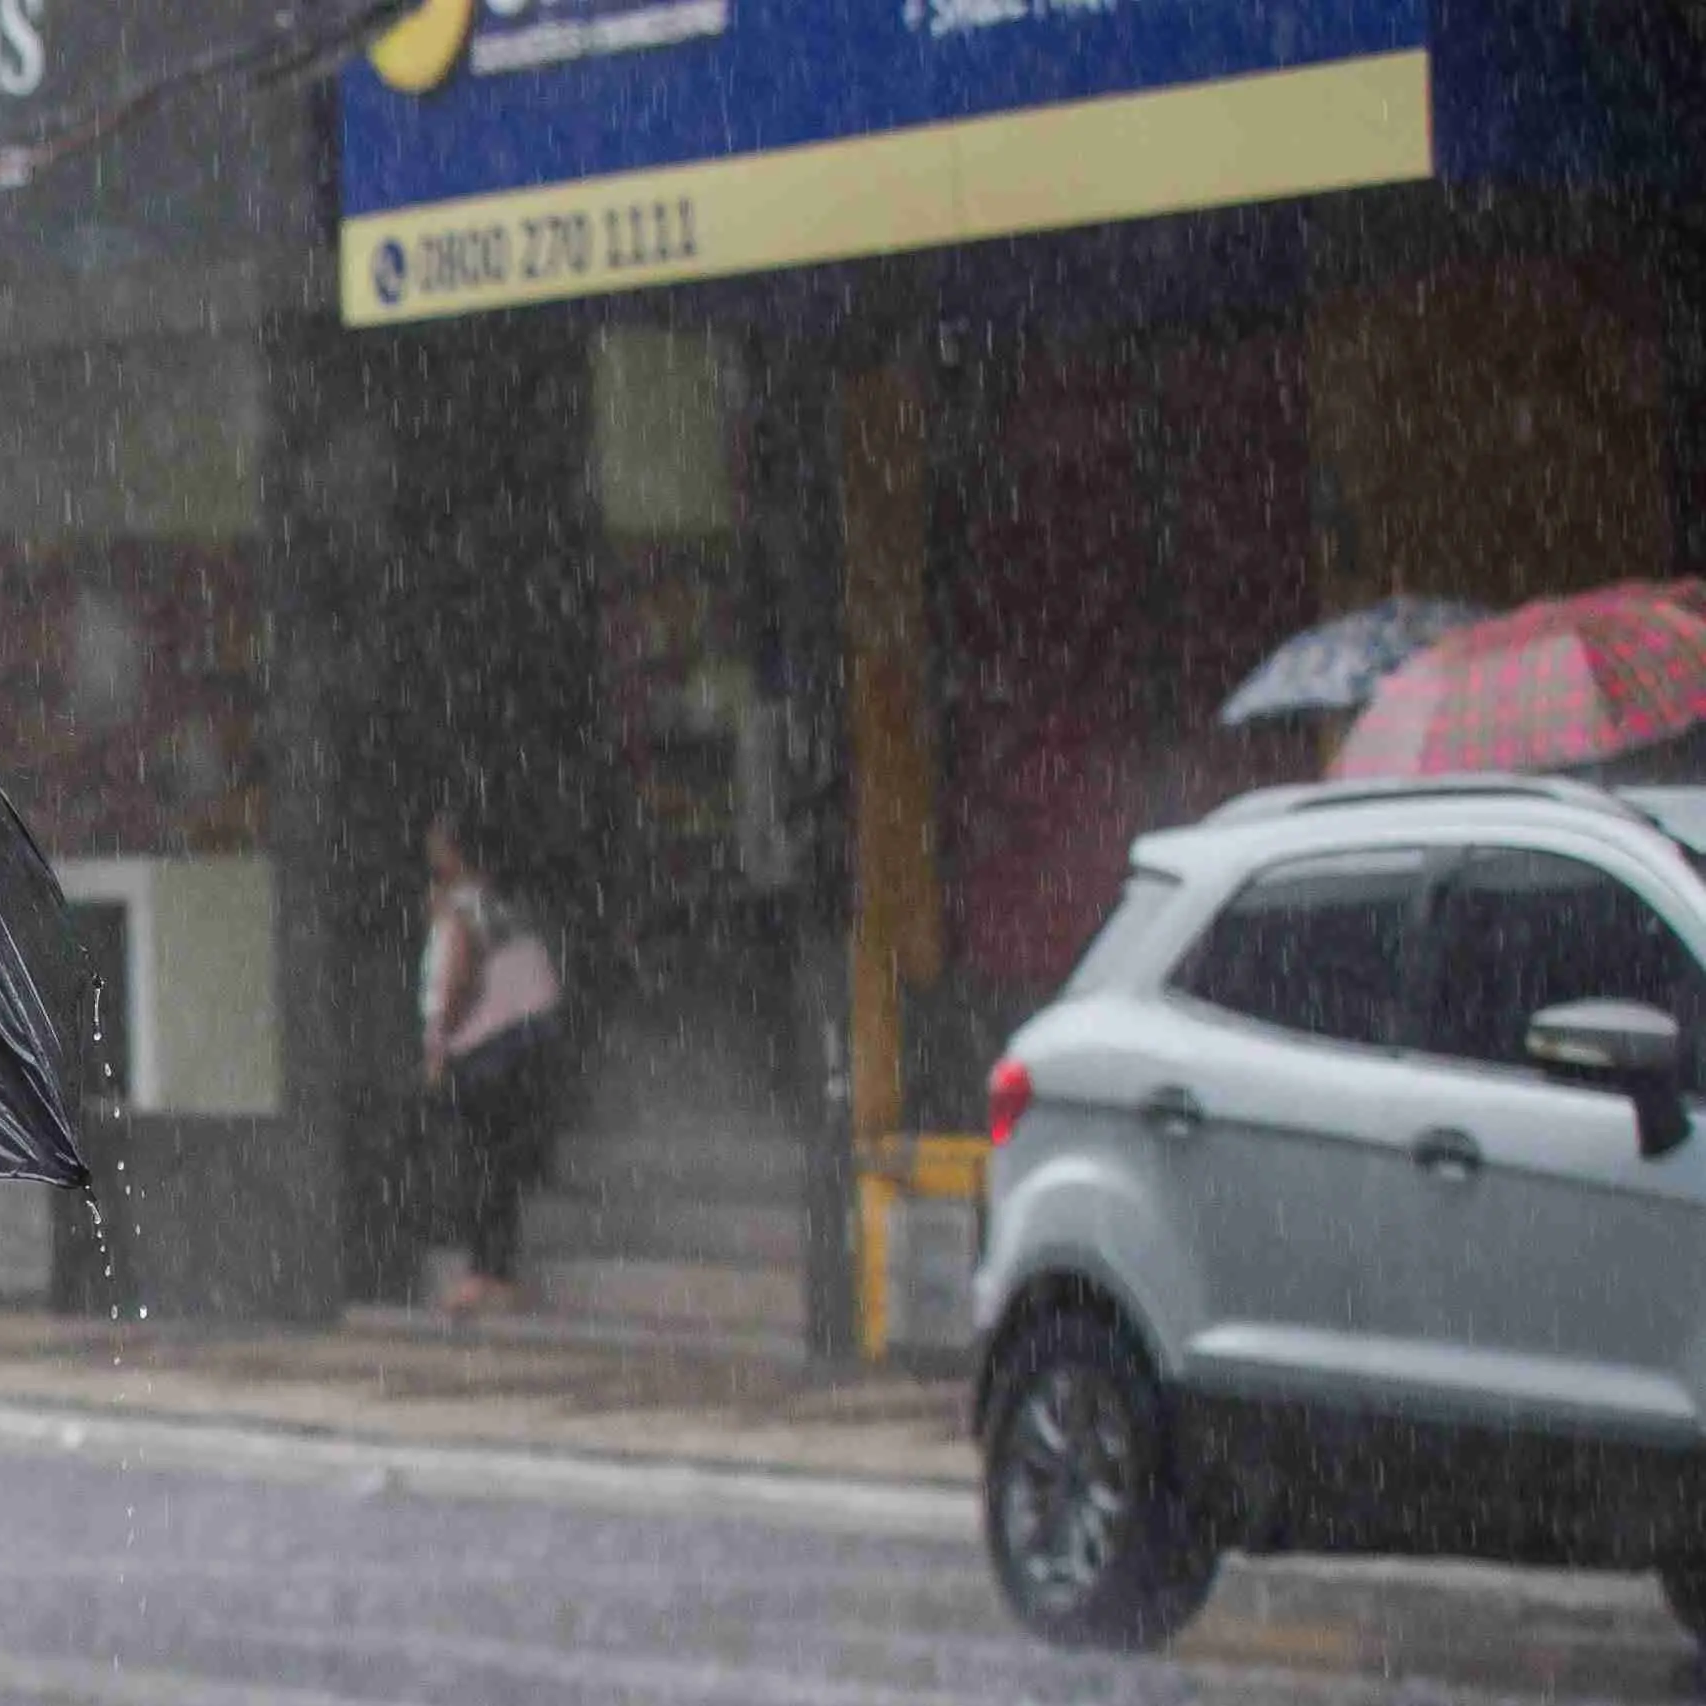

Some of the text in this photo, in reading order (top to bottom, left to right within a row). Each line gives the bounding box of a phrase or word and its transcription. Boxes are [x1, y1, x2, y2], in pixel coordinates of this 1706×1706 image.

[416, 195, 698, 294] 0800 270 1111
